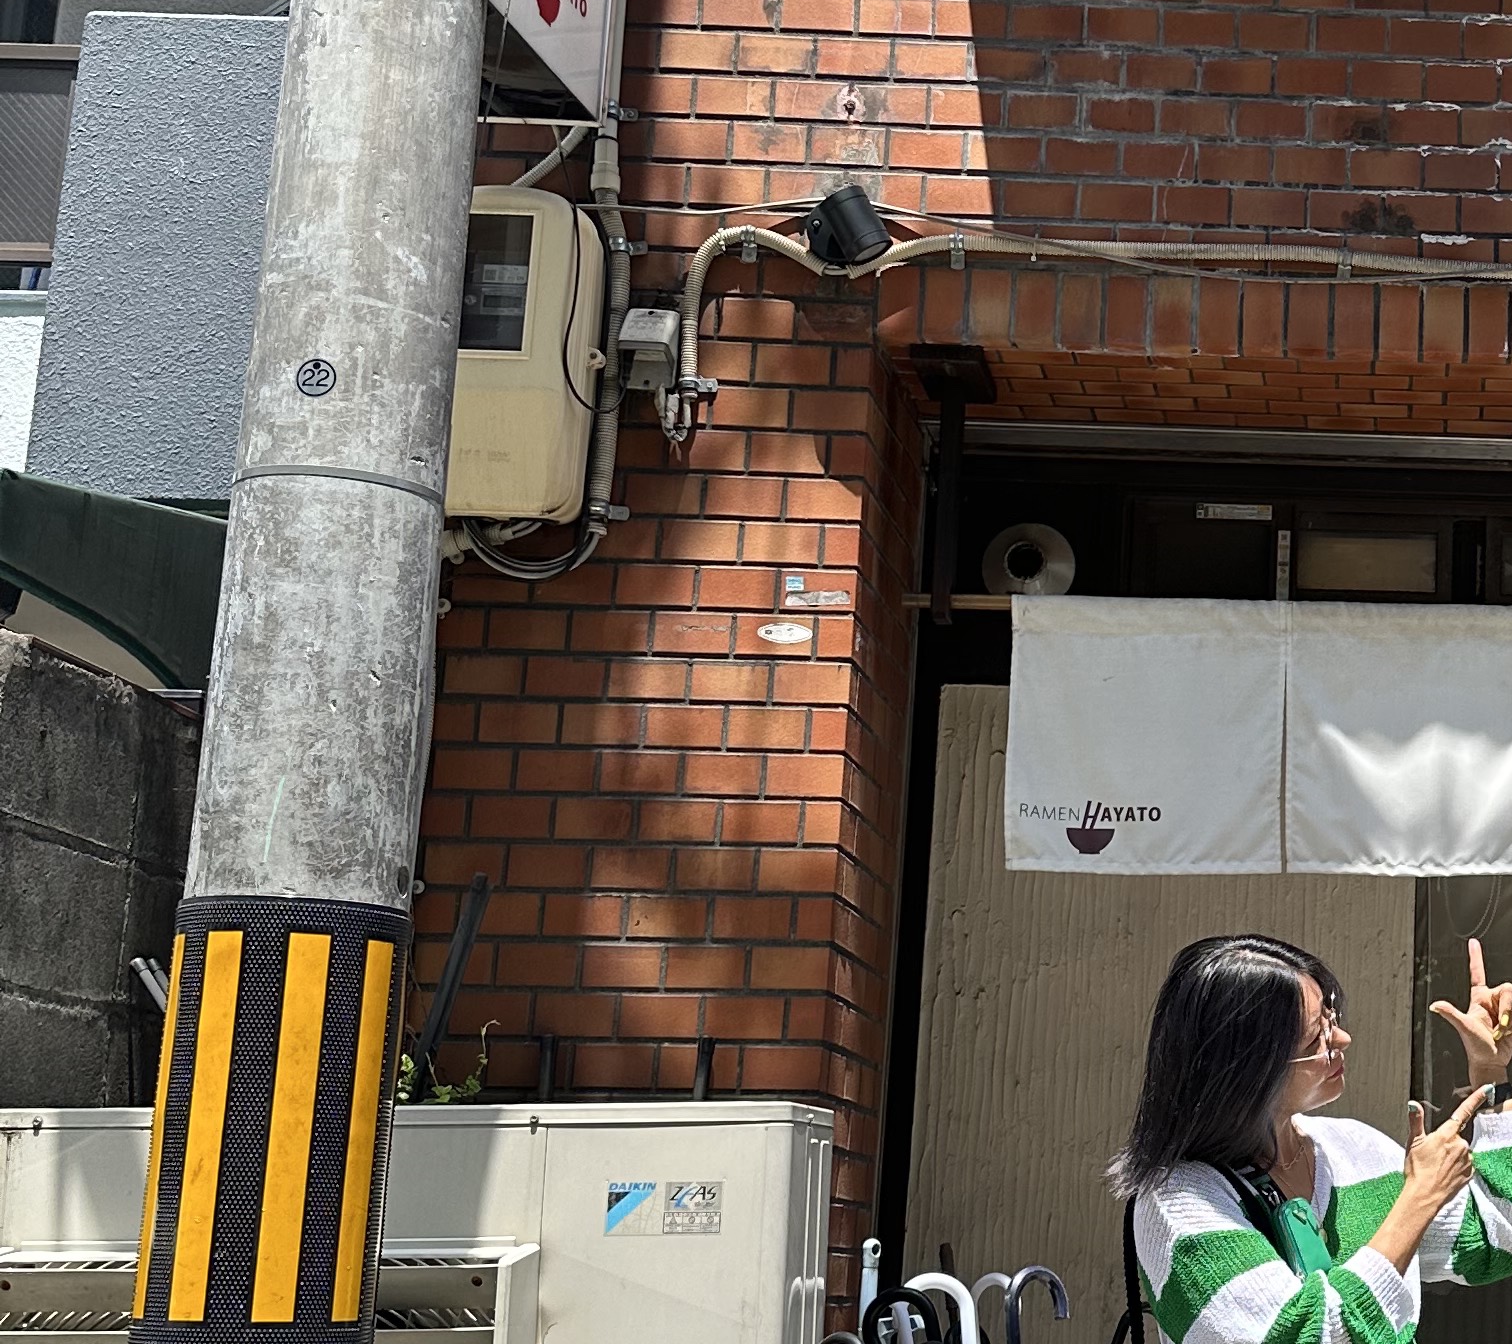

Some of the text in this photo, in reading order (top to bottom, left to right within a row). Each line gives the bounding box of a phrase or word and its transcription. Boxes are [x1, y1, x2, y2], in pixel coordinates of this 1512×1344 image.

[302, 368, 330, 387] 22
[1019, 800, 1162, 830] RAMEN HAYATO
[608, 1182, 657, 1191] DAIKIN
